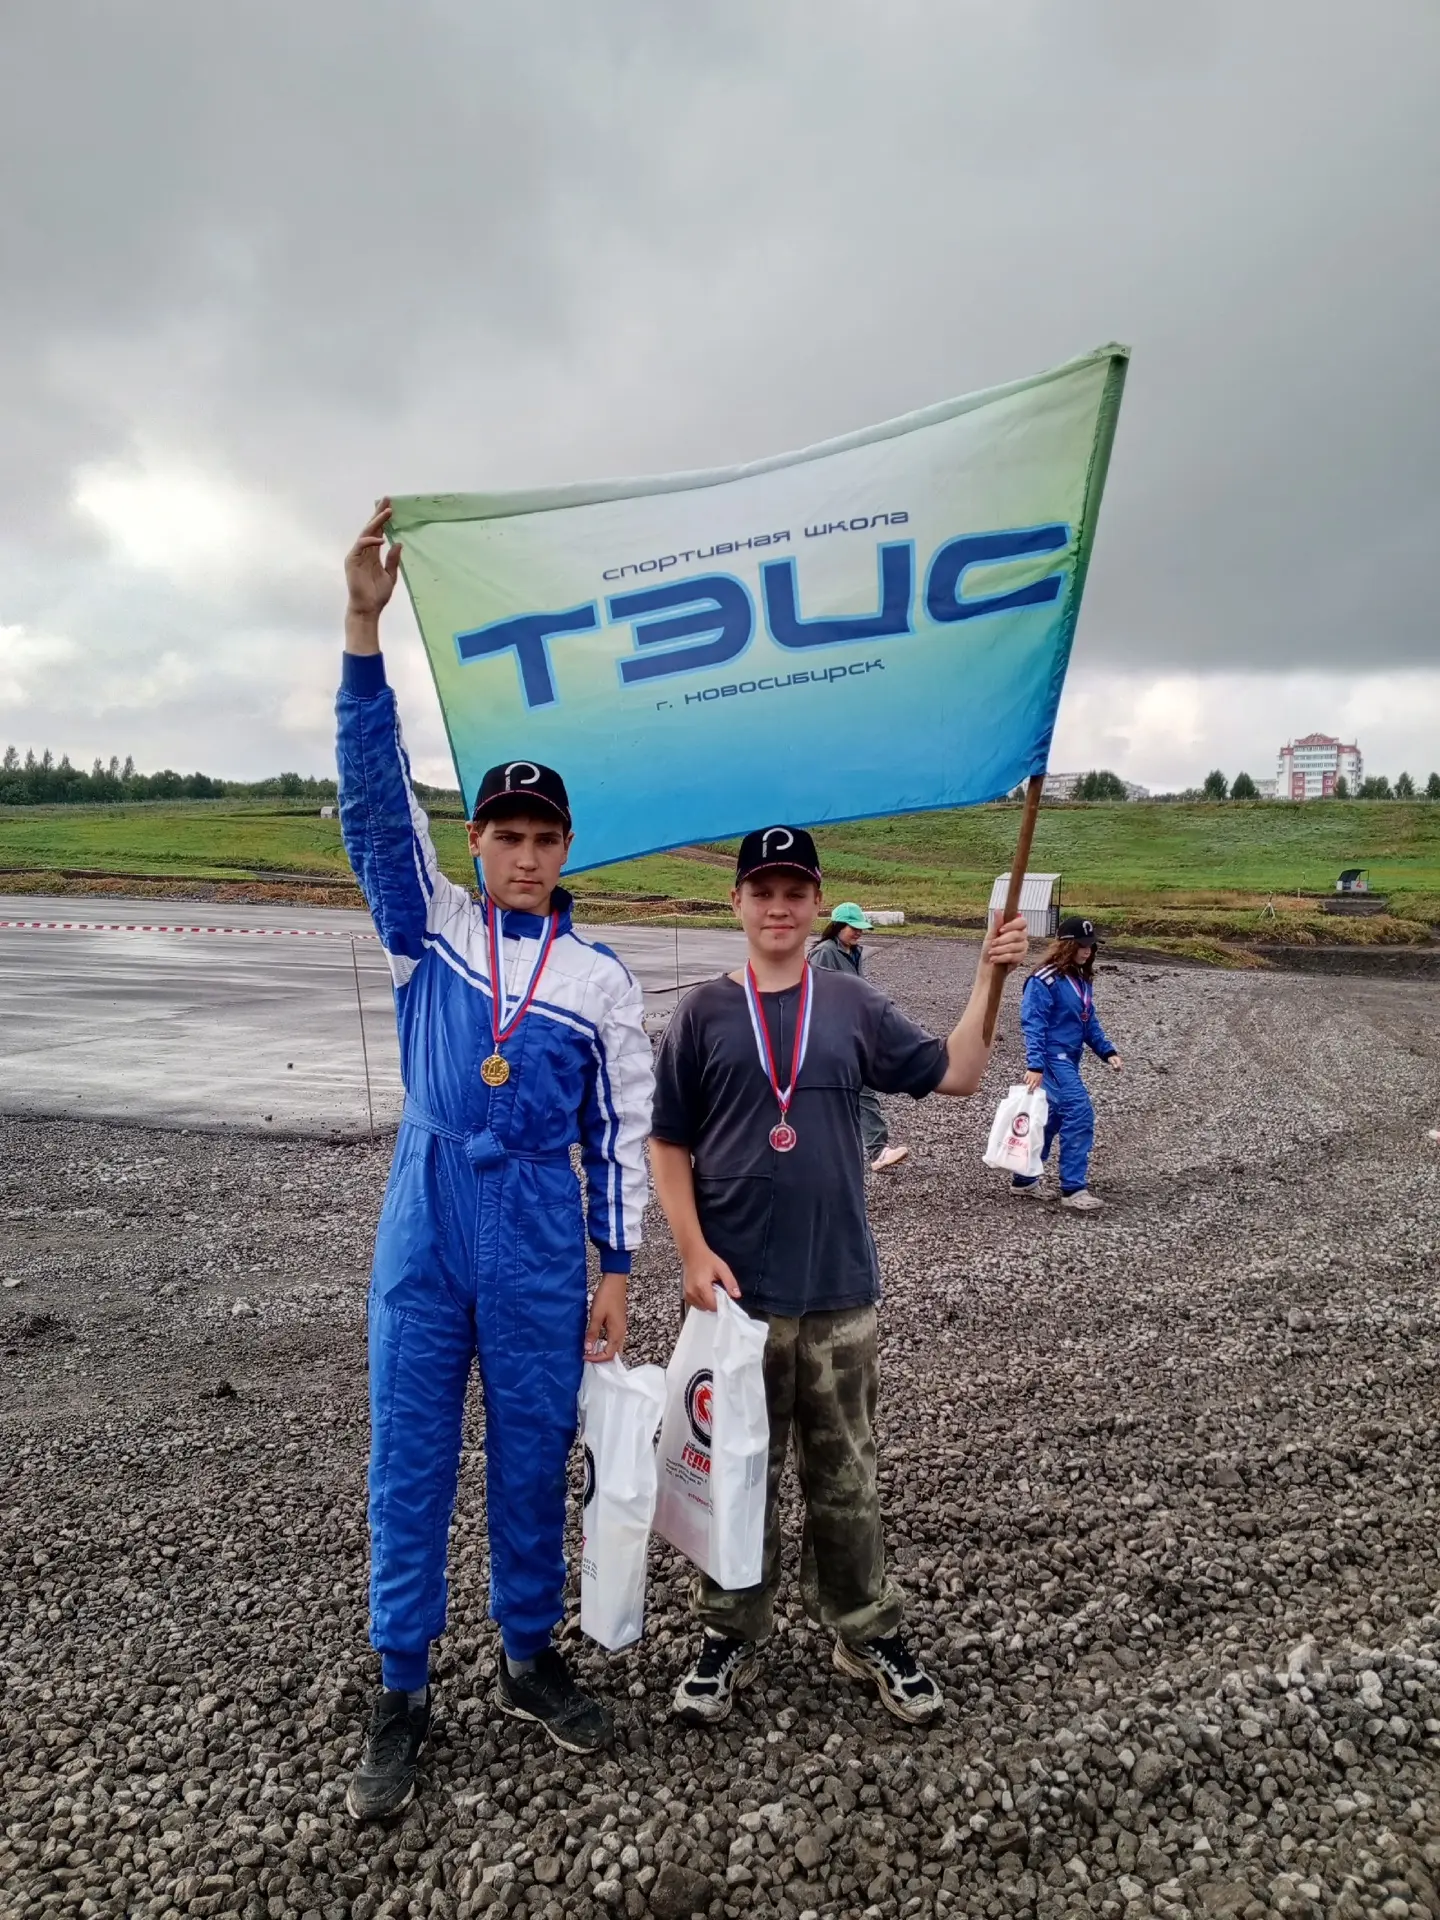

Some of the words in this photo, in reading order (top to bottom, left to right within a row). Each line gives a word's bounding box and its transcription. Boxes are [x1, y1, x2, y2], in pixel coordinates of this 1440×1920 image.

[602, 529, 791, 581] спортивная
[803, 510, 909, 538] школа
[453, 521, 1070, 712] ТЭИС
[656, 700, 673, 711] г.
